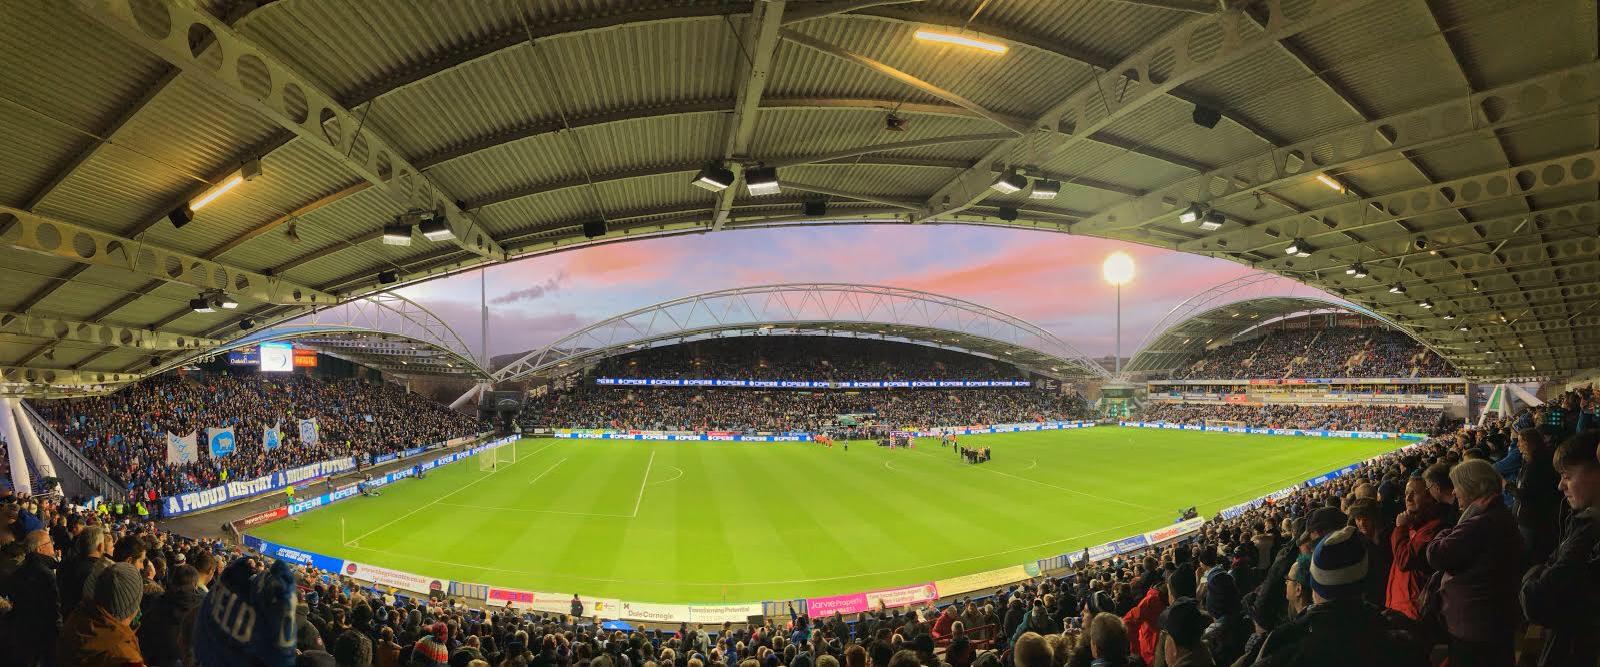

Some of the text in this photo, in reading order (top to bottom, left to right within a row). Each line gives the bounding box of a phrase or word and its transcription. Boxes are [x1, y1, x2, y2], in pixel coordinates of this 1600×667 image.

[169, 496, 181, 513] A
[182, 486, 227, 511] PROUD
[278, 472, 288, 487] A
